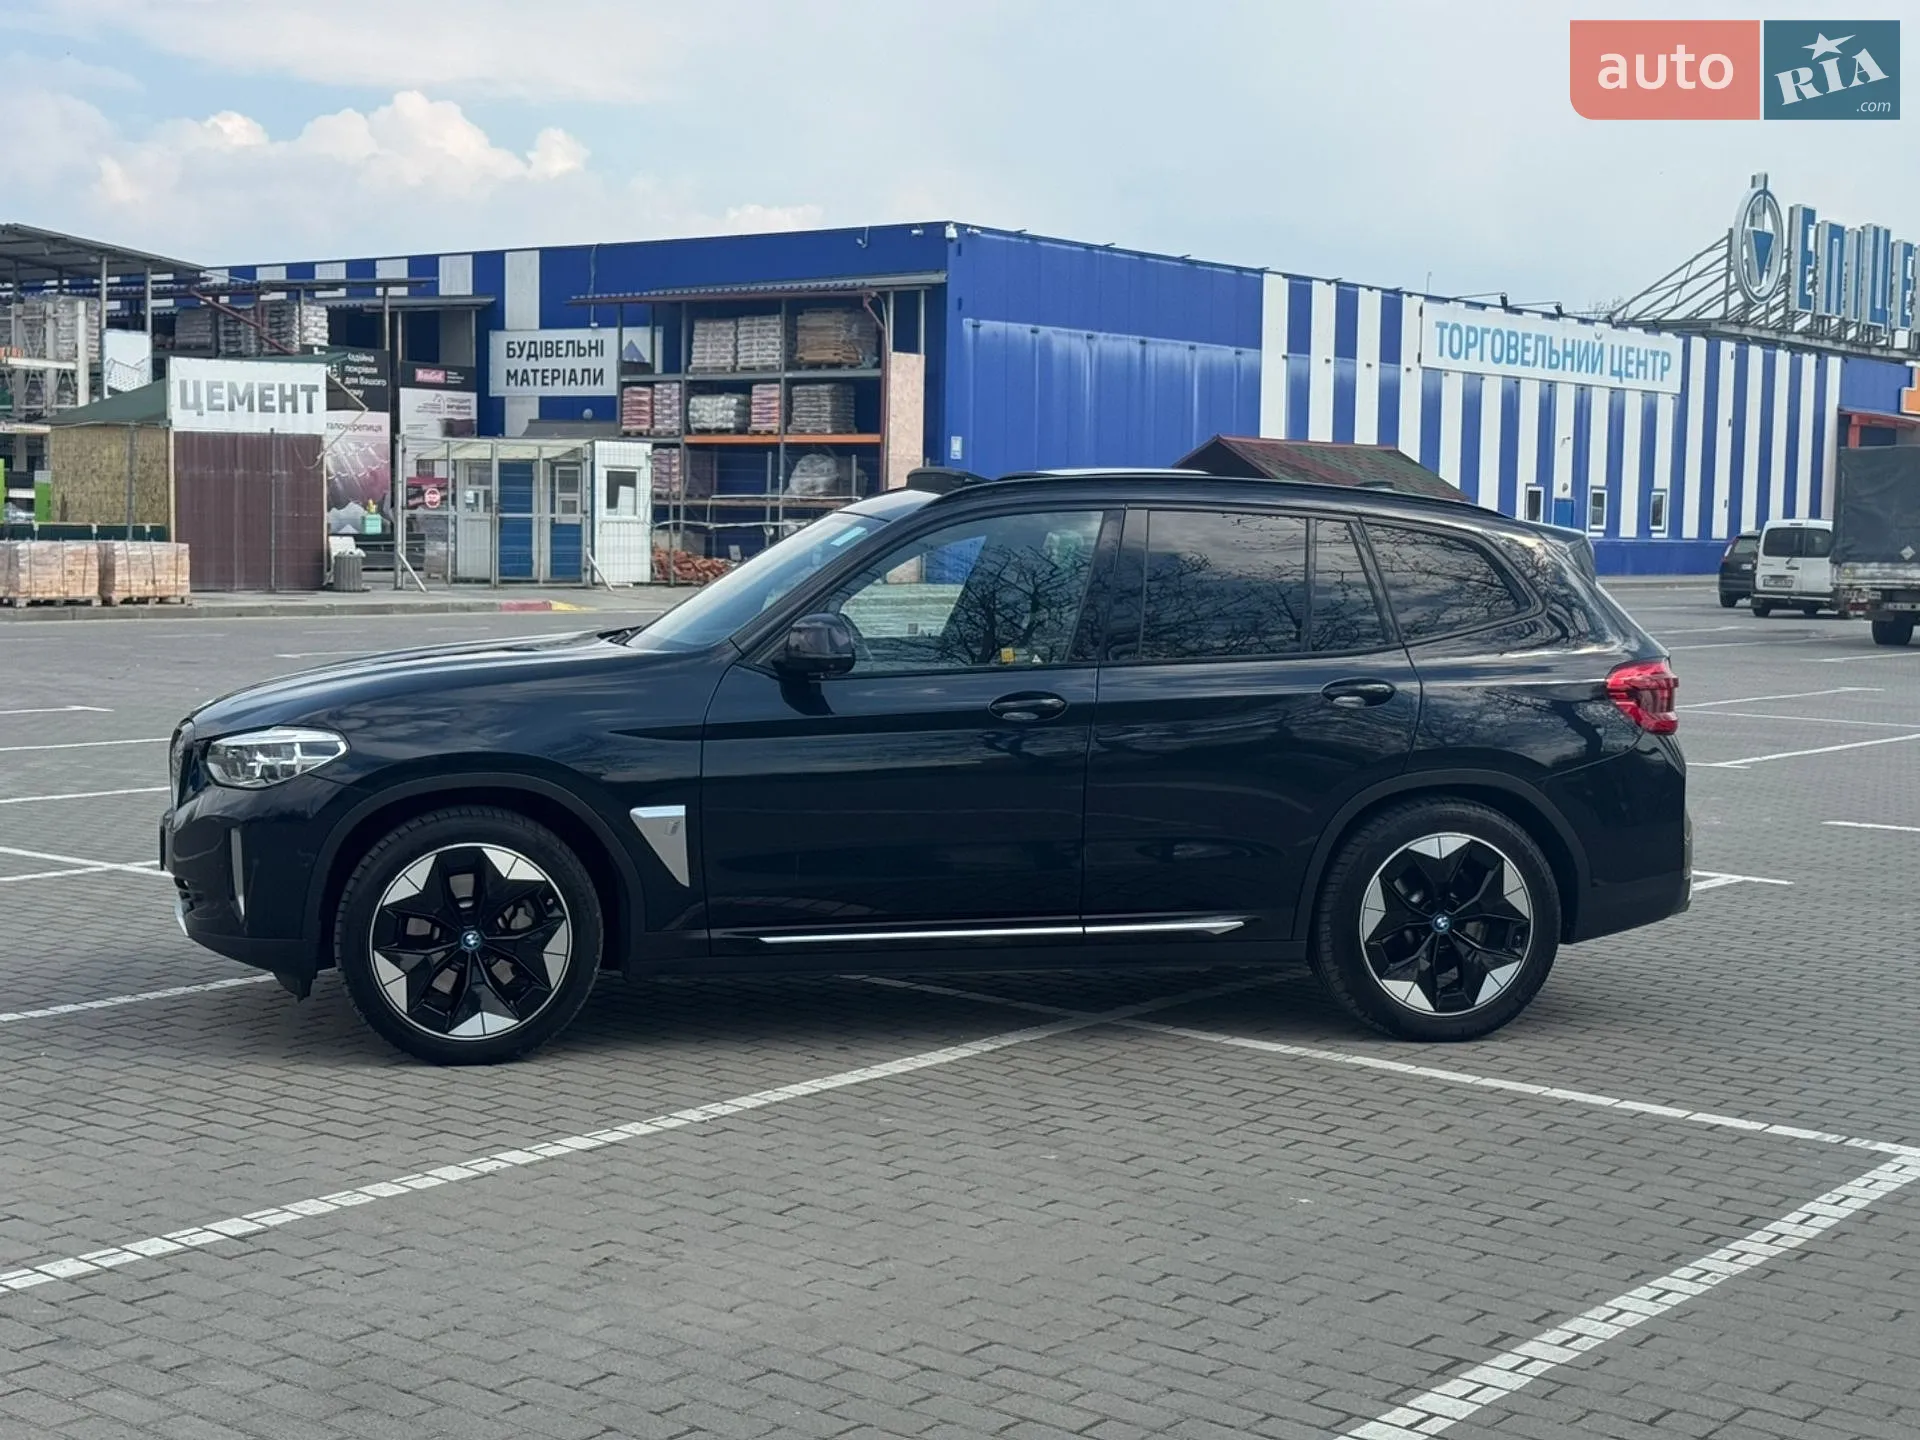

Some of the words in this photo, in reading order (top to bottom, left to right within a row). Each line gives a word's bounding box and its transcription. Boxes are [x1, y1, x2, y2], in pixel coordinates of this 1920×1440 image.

[1788, 204, 1920, 337] ЕПІЦЕ
[505, 339, 604, 361] БУДІВЕЛЬНІ
[1435, 321, 1604, 375] ТОРГОВЕЛЬНИЙ
[1609, 344, 1671, 383] ЦЕНТР
[505, 367, 604, 387] МАТЕРІАЛИ
[179, 379, 319, 416] ЦЕМЕНТ
